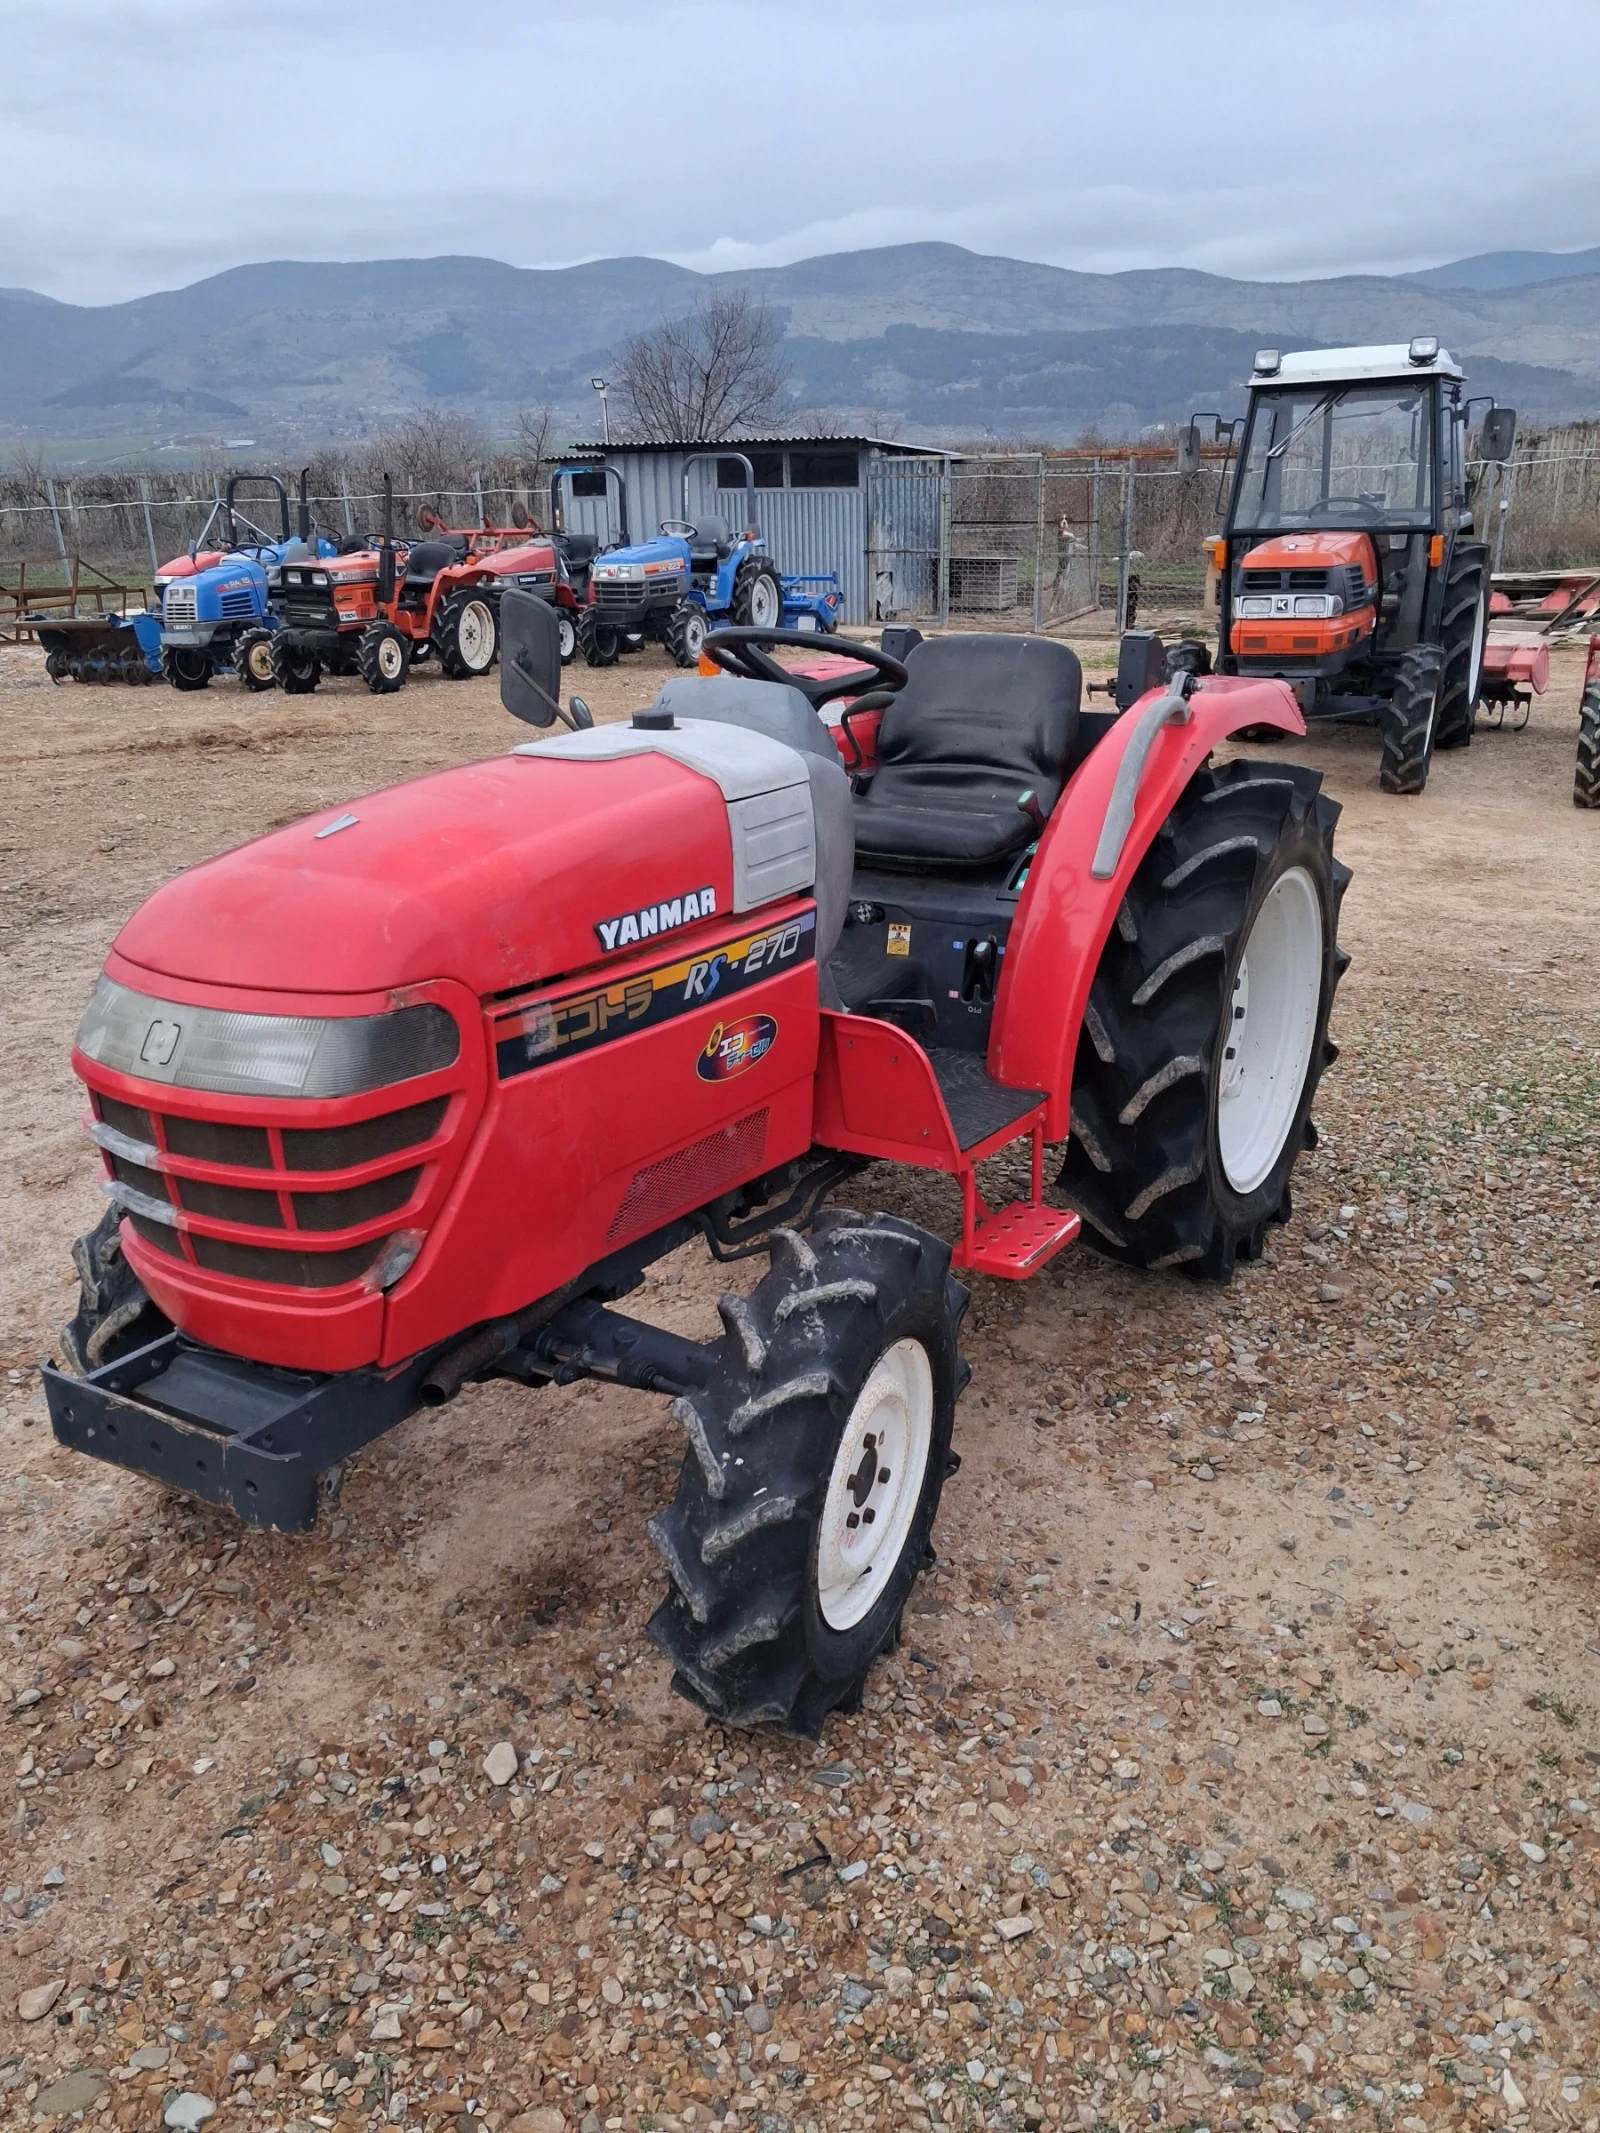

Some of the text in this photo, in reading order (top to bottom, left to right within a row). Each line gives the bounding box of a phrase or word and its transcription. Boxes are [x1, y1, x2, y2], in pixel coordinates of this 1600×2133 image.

[1277, 600, 1287, 610] K
[598, 887, 716, 950] YANMAR
[719, 1032, 745, 1057] エコ
